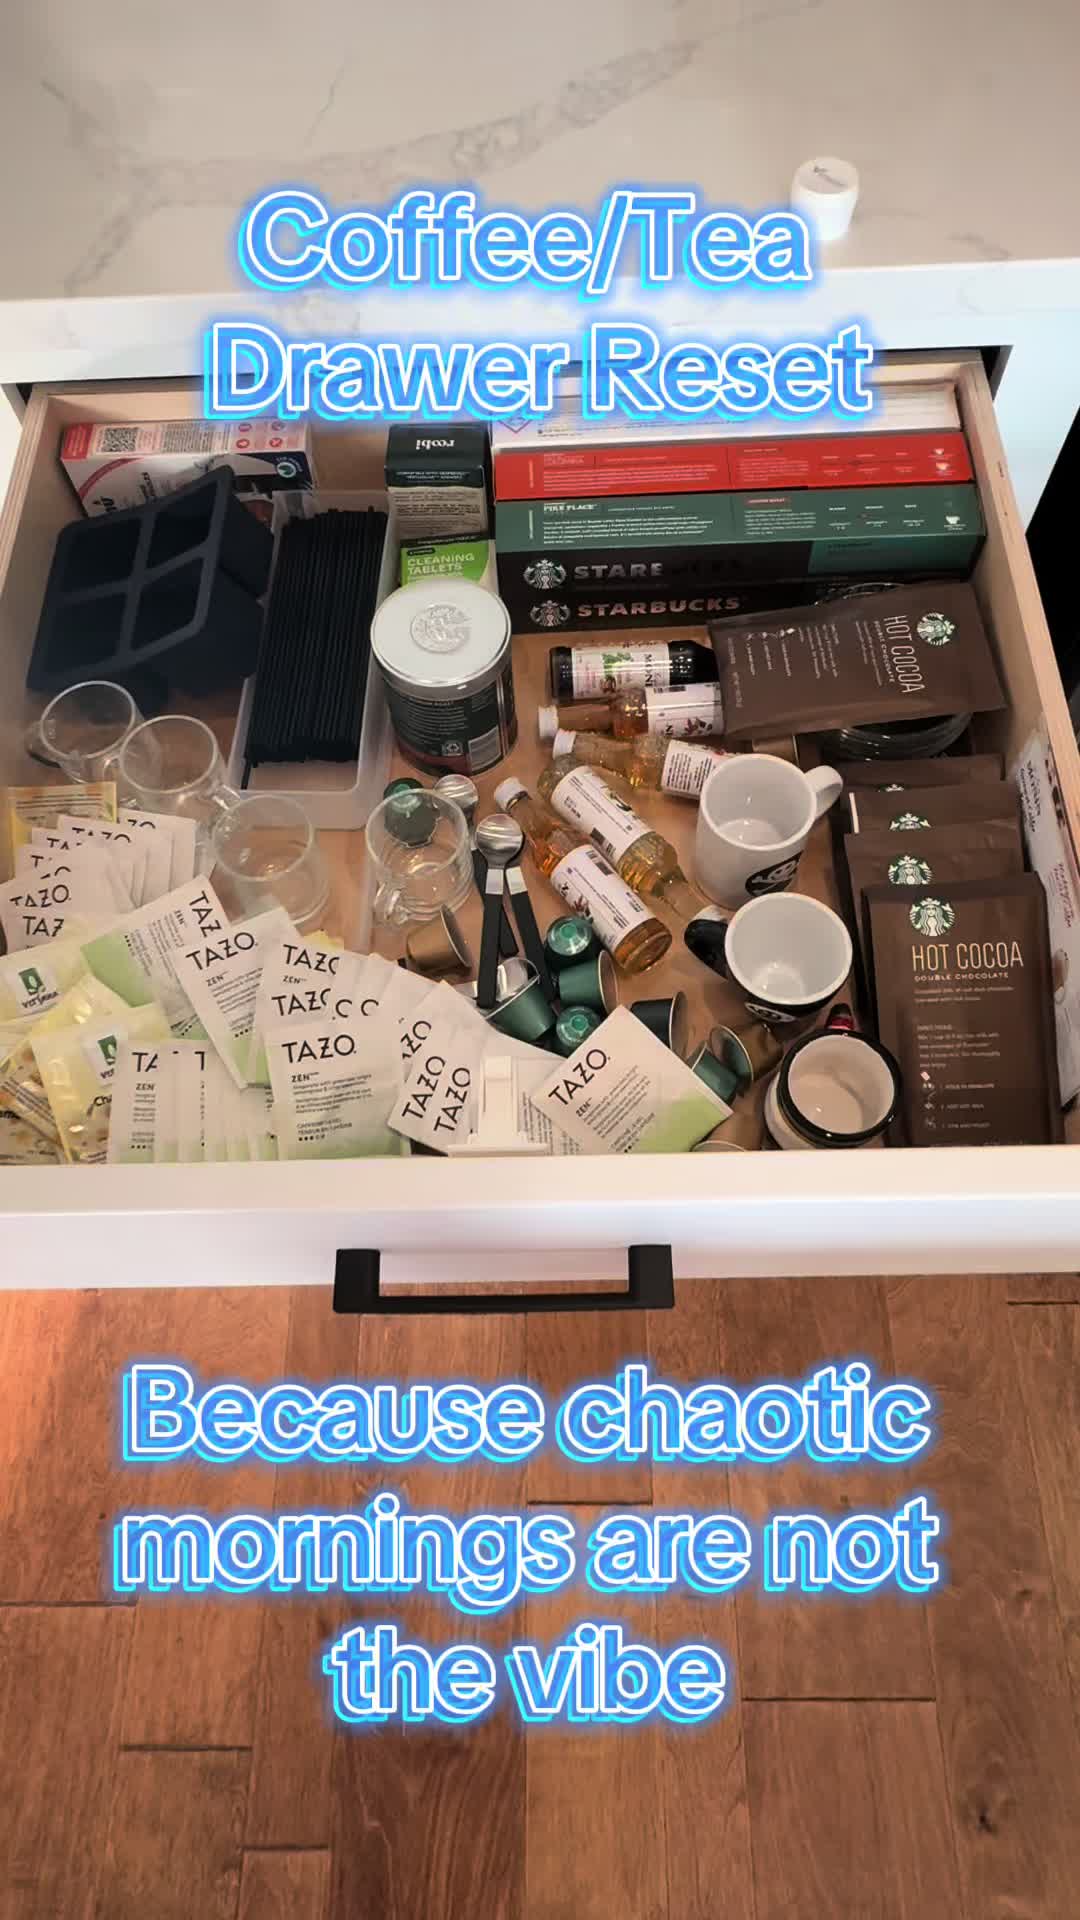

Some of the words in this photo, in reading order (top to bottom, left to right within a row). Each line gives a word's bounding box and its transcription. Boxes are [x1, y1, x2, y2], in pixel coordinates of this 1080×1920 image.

[407, 552, 475, 567] CLEANING
[408, 562, 463, 575] TABLETS
[578, 597, 741, 618] STARBUCKS
[884, 615, 912, 642] HOT
[880, 643, 896, 683] CHOCOLATE
[890, 645, 925, 694] COCOA
[189, 890, 222, 938] TAZ
[23, 916, 64, 937] TAZ
[911, 943, 950, 972] HOT
[956, 941, 1024, 971] COCOA
[206, 974, 224, 987] ZEN
[914, 973, 951, 982] DOUBLE
[954, 971, 1009, 981] CHOCOLATE
[135, 1083, 155, 1091] ZEN
[291, 1073, 311, 1083] ZEN
[433, 1067, 471, 1132] TAZO
